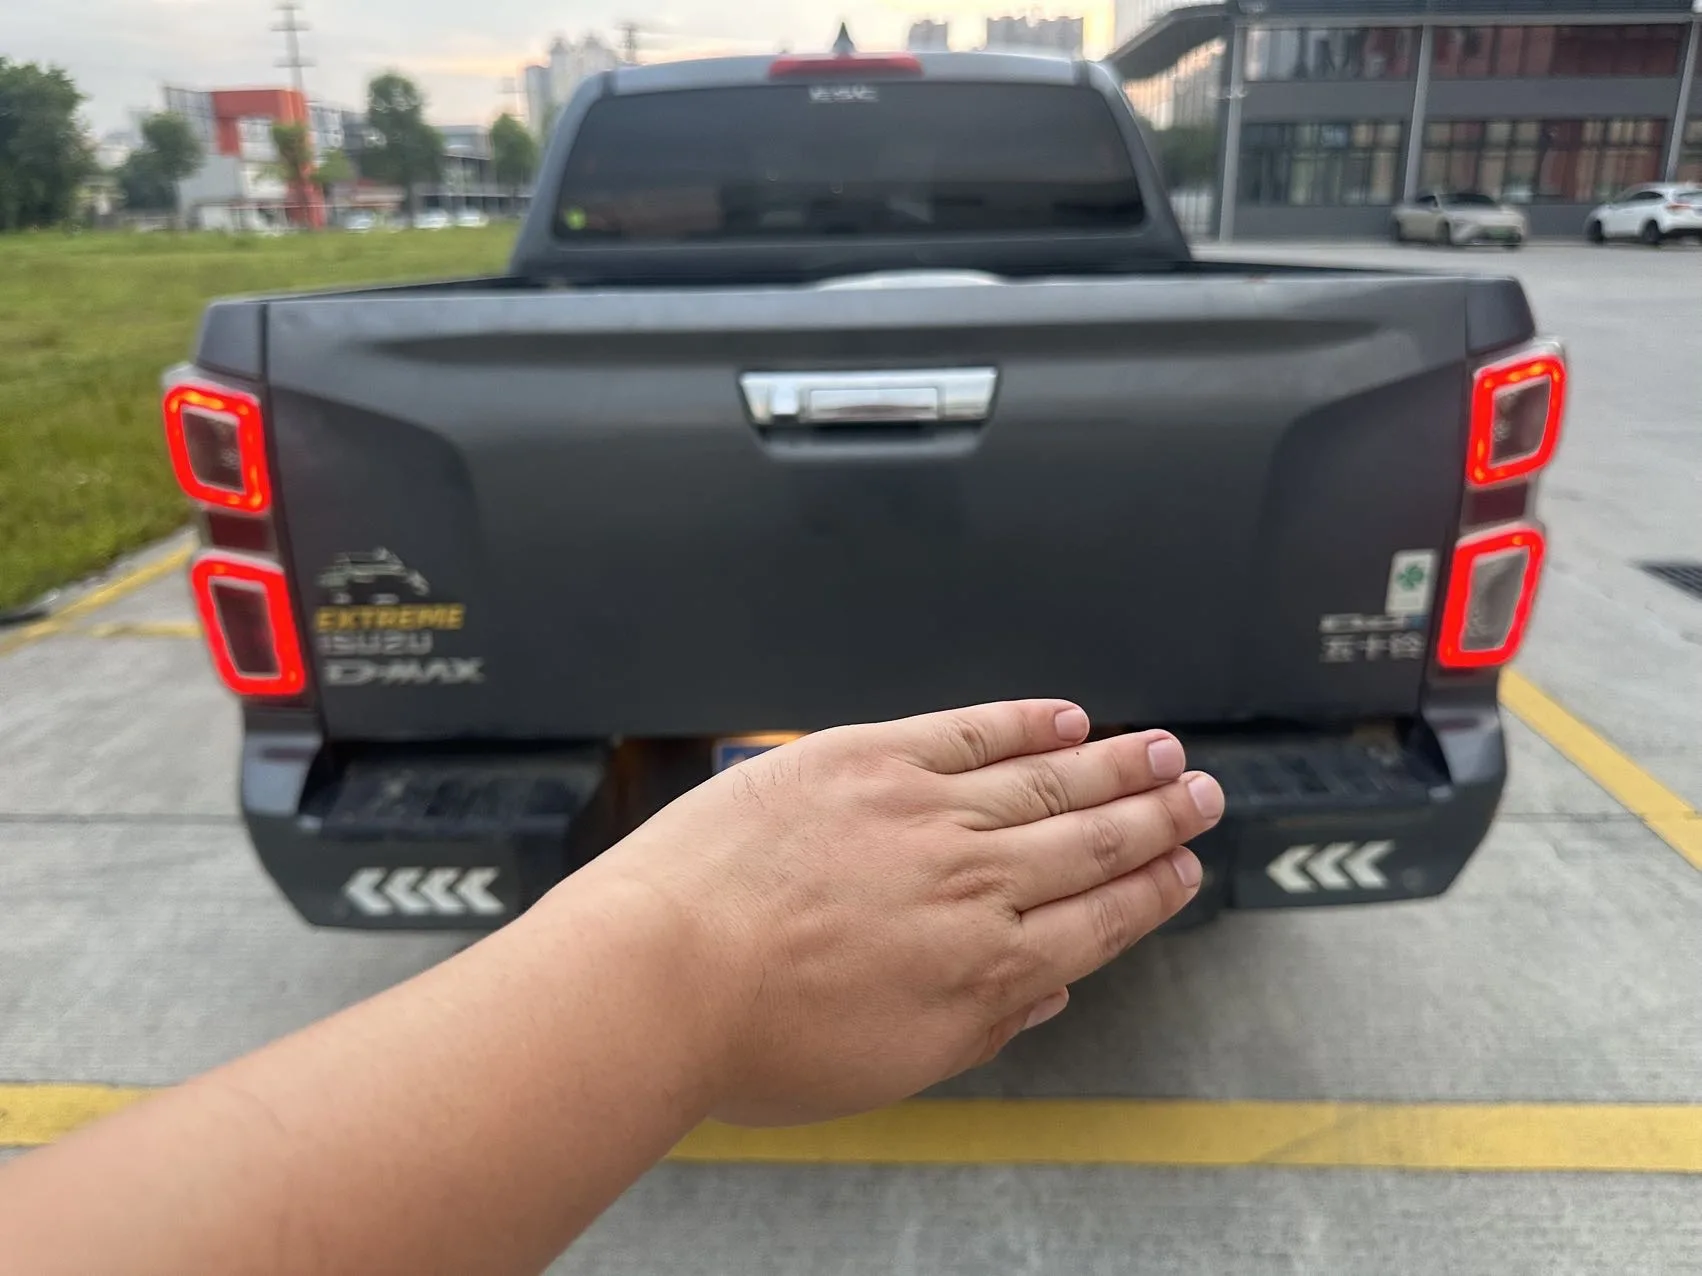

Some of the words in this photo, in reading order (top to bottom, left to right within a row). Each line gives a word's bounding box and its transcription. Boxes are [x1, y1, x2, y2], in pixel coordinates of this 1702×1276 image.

[316, 604, 464, 631] EXTREME
[317, 631, 432, 655] ISUZU
[324, 657, 484, 685] D-MAX
